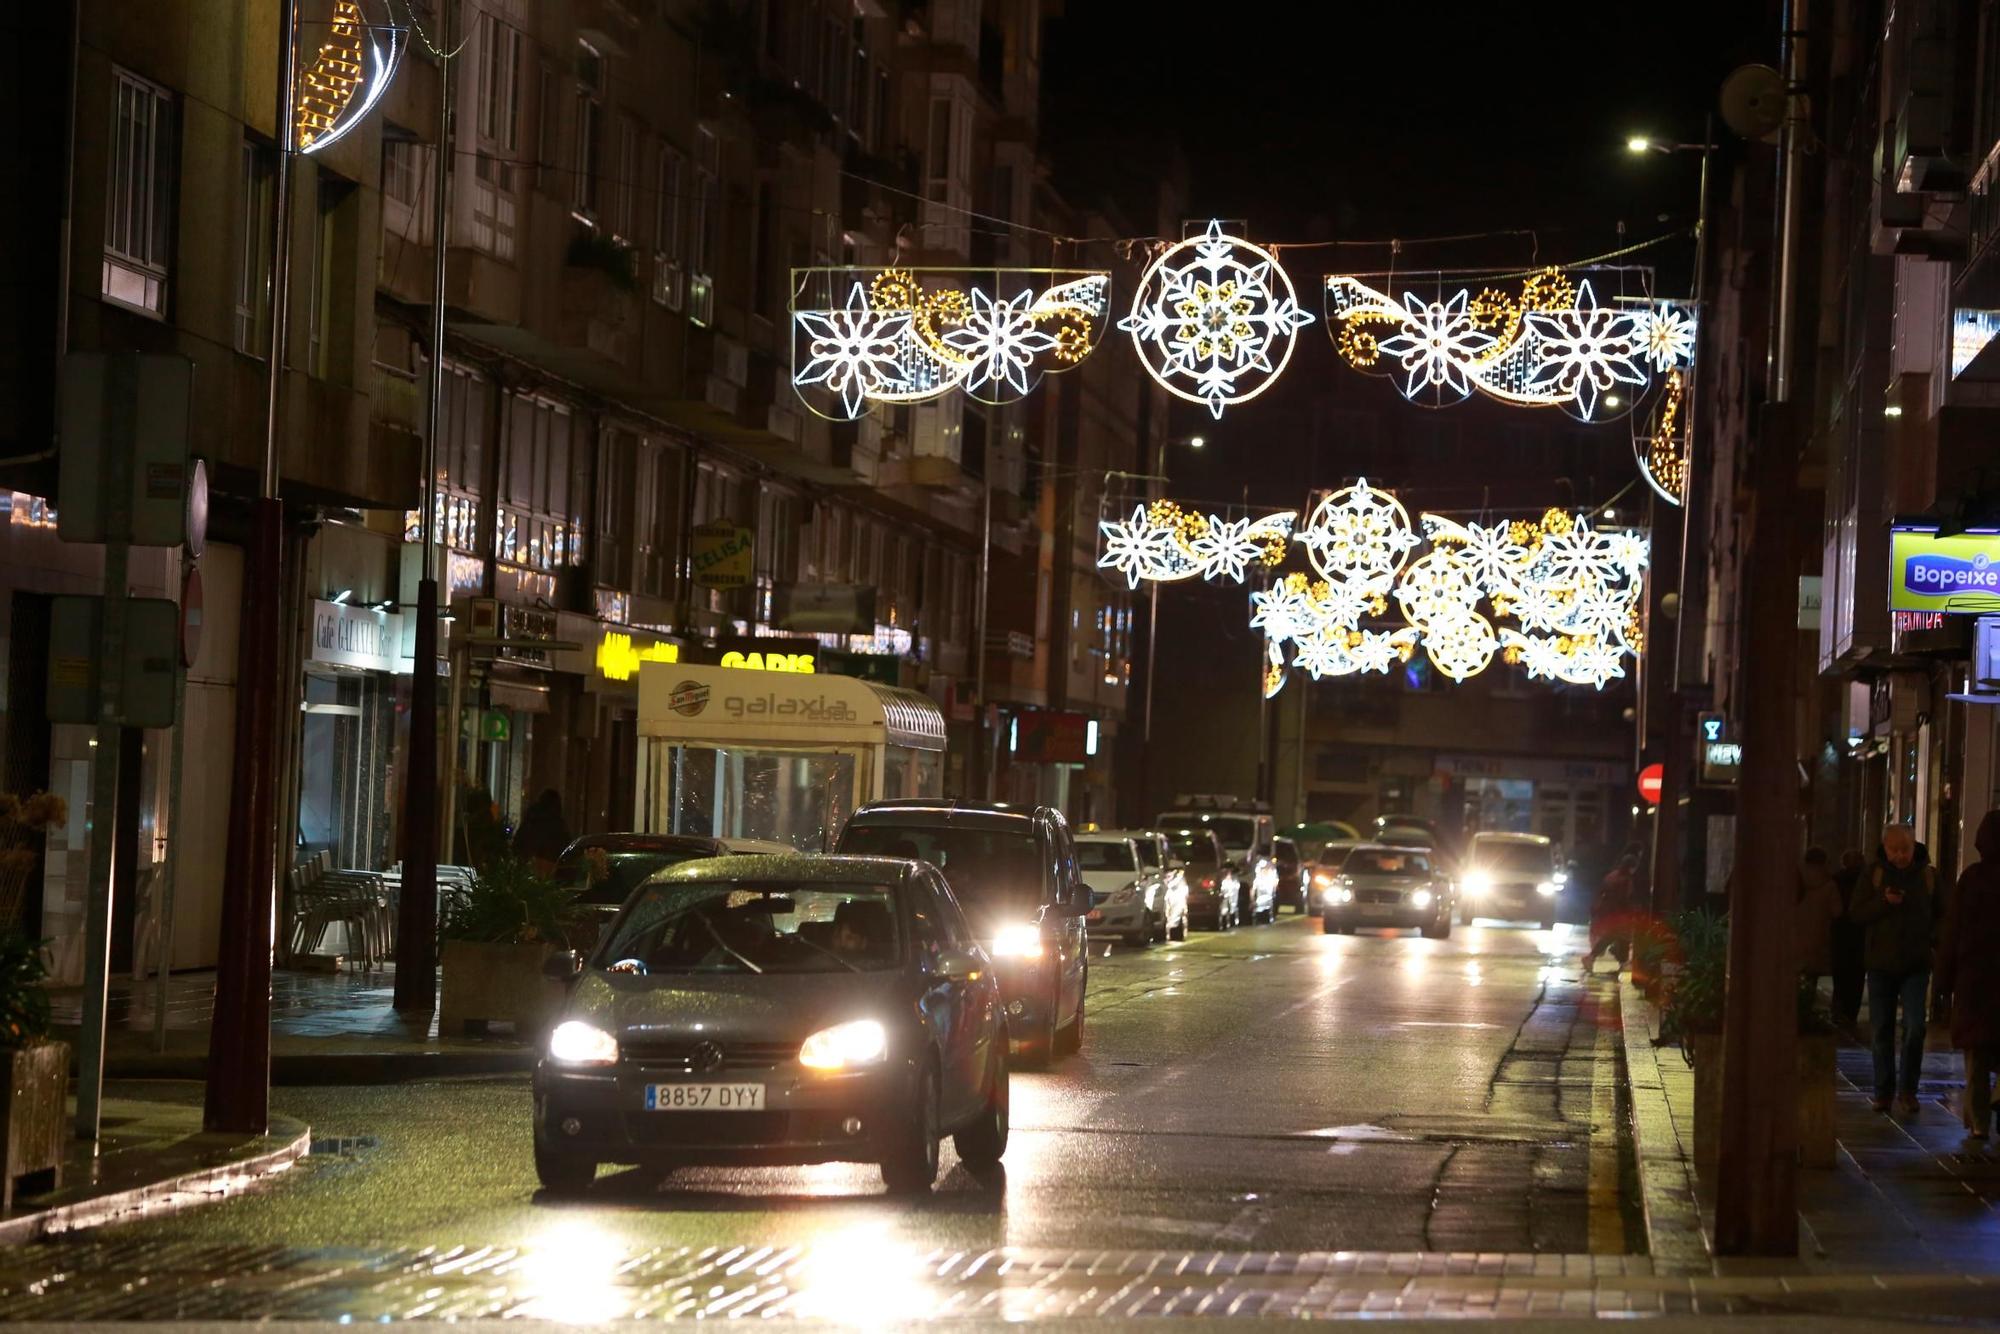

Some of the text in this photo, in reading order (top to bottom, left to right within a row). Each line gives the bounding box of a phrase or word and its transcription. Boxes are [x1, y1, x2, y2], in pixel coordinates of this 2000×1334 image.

[1914, 565, 1998, 589] Bopeixe
[720, 651, 815, 674] GADIS
[724, 693, 848, 717] galaxia
[660, 1087, 758, 1106] 8857 DYY
